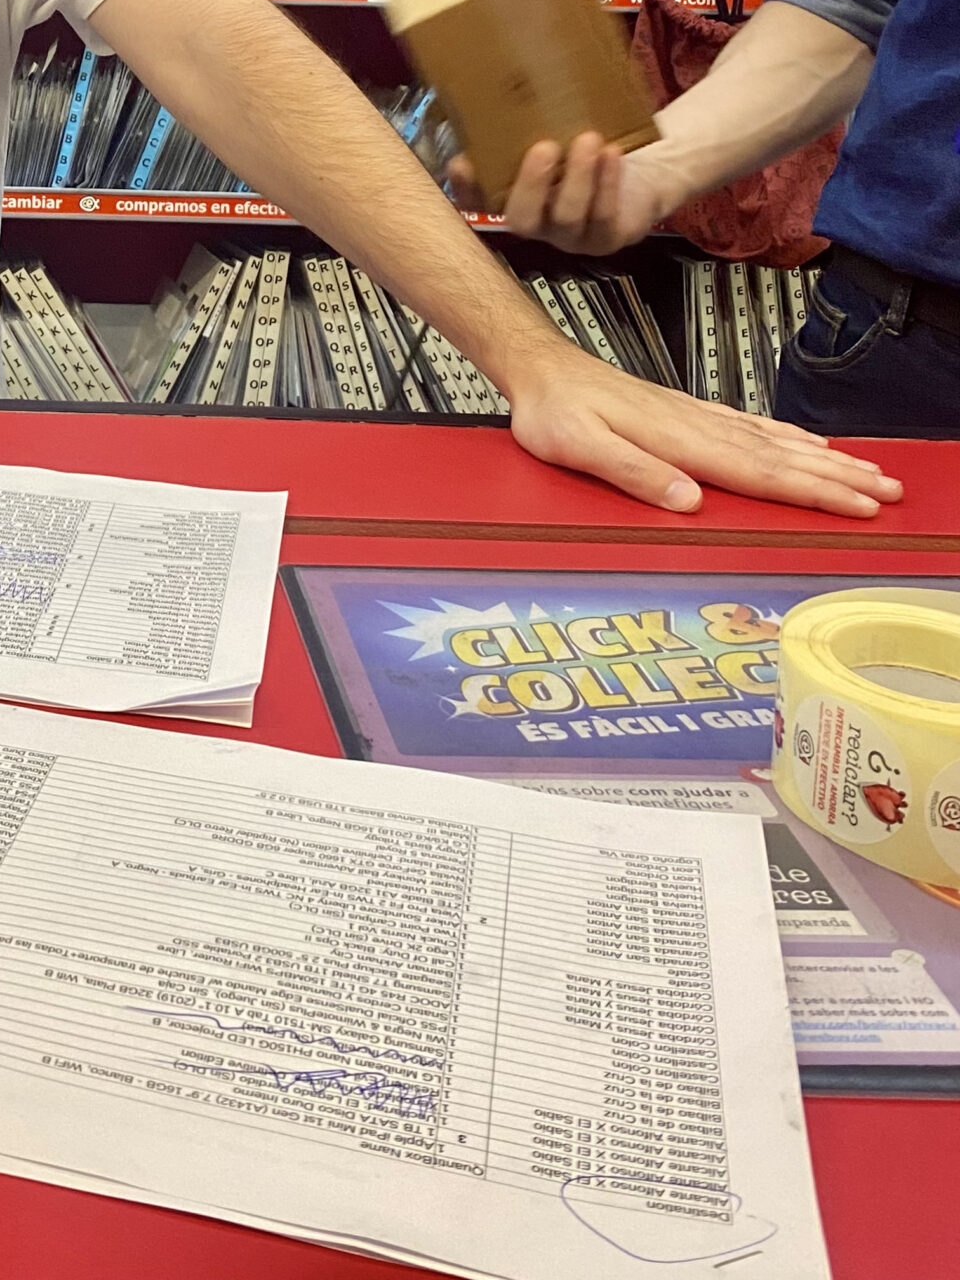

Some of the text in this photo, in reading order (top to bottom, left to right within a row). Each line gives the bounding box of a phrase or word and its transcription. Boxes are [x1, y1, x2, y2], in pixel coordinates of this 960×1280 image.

[1, 196, 63, 210] cambiar
[115, 200, 207, 214] compramos
[211, 202, 230, 214] en
[450, 602, 781, 669] CLICK &
[460, 648, 781, 717] COLLEC
[516, 707, 776, 743] ÉS FÀCIL I GRA
[817, 762, 829, 811] EFECTIVO
[841, 722, 862, 828] reciclar?
[572, 784, 626, 796] sobre
[628, 788, 668, 797] com
[673, 786, 733, 799] ajudar
[737, 790, 750, 798] a
[603, 1109, 723, 1137] Bilbao de la Cruz
[359, 1141, 402, 1159] Name
[645, 1200, 731, 1223] Destination
